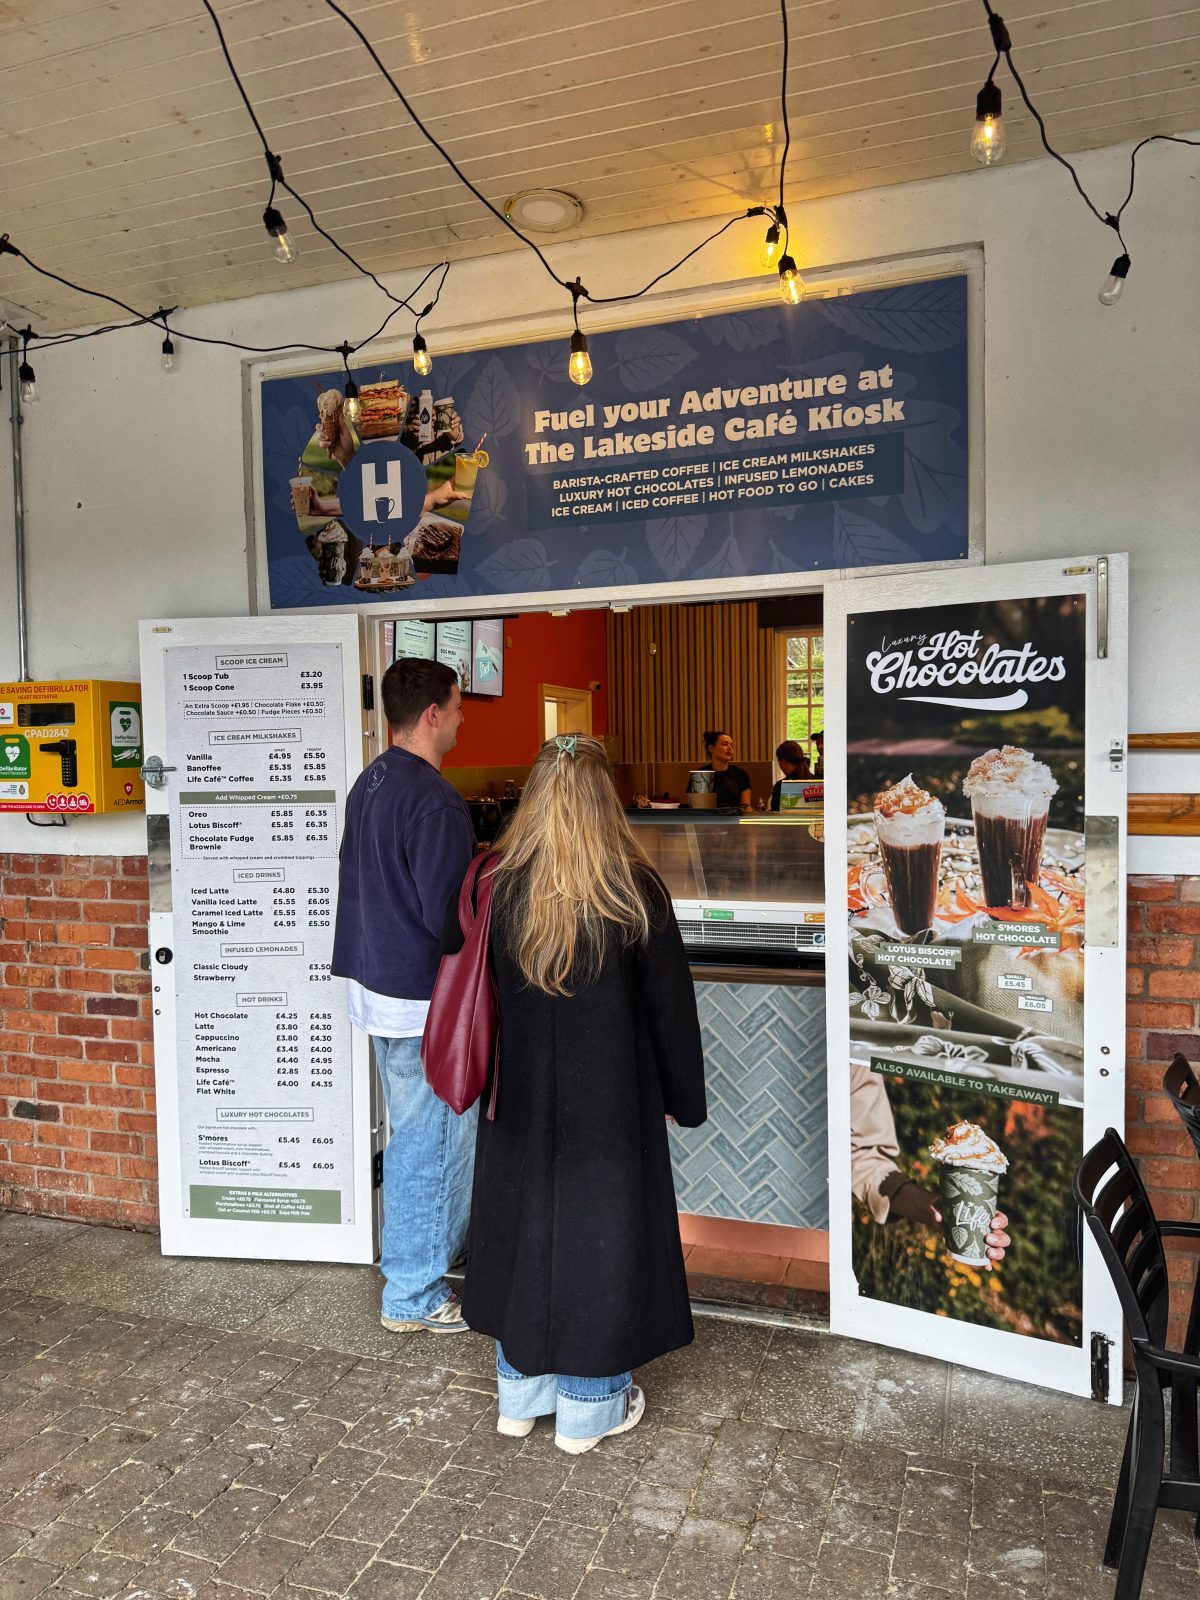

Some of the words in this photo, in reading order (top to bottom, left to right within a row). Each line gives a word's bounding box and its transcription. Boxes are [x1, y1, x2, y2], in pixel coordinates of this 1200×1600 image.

[534, 405, 594, 433] Fuel
[603, 398, 670, 428] your
[680, 373, 846, 414] Adventure
[858, 363, 894, 390] at
[525, 438, 574, 466] The
[584, 420, 714, 459] Lakeside
[724, 408, 797, 441] Café
[808, 398, 905, 431] Kiosk
[553, 469, 658, 489] BARISTA-CRAFTED
[662, 463, 709, 478] COFFEE
[719, 459, 738, 472] ICE
[742, 453, 787, 469] CREAM
[790, 444, 875, 464] MILKSHAKES
[559, 487, 604, 503] LUXURY
[607, 484, 631, 497] HOT
[633, 477, 714, 495] CHOCOLATES
[724, 470, 778, 485] INFUSED
[782, 460, 864, 478] LEMONADES
[361, 460, 403, 522] H
[551, 505, 570, 517] ICE
[572, 502, 613, 515] CREAM
[622, 497, 650, 509] ICED
[652, 492, 699, 507] COFFEE
[709, 489, 736, 501] HOT
[738, 484, 774, 498] FOOD
[776, 482, 796, 494] TO
[798, 480, 818, 492] GO
[829, 473, 874, 488] CAKES
[882, 632, 927, 652] Luxury
[918, 630, 983, 661] Hot
[866, 642, 1066, 693] Chocolates
[34, 684, 89, 693] DEFIBRILLATOR
[24, 728, 69, 738] CPAD2842
[997, 924, 1040, 933] S'MORES
[997, 934, 1057, 944] CHOCOLATE
[877, 954, 896, 962] HOT
[897, 955, 952, 966] CHOCOLATE
[888, 945, 917, 953] LOTUS
[875, 1062, 904, 1074] ALSO
[906, 1068, 965, 1086] AVAILABLE
[967, 1080, 984, 1090] TO
[986, 1084, 1053, 1103] TAKEAWAY!
[956, 1200, 989, 1231] Life
